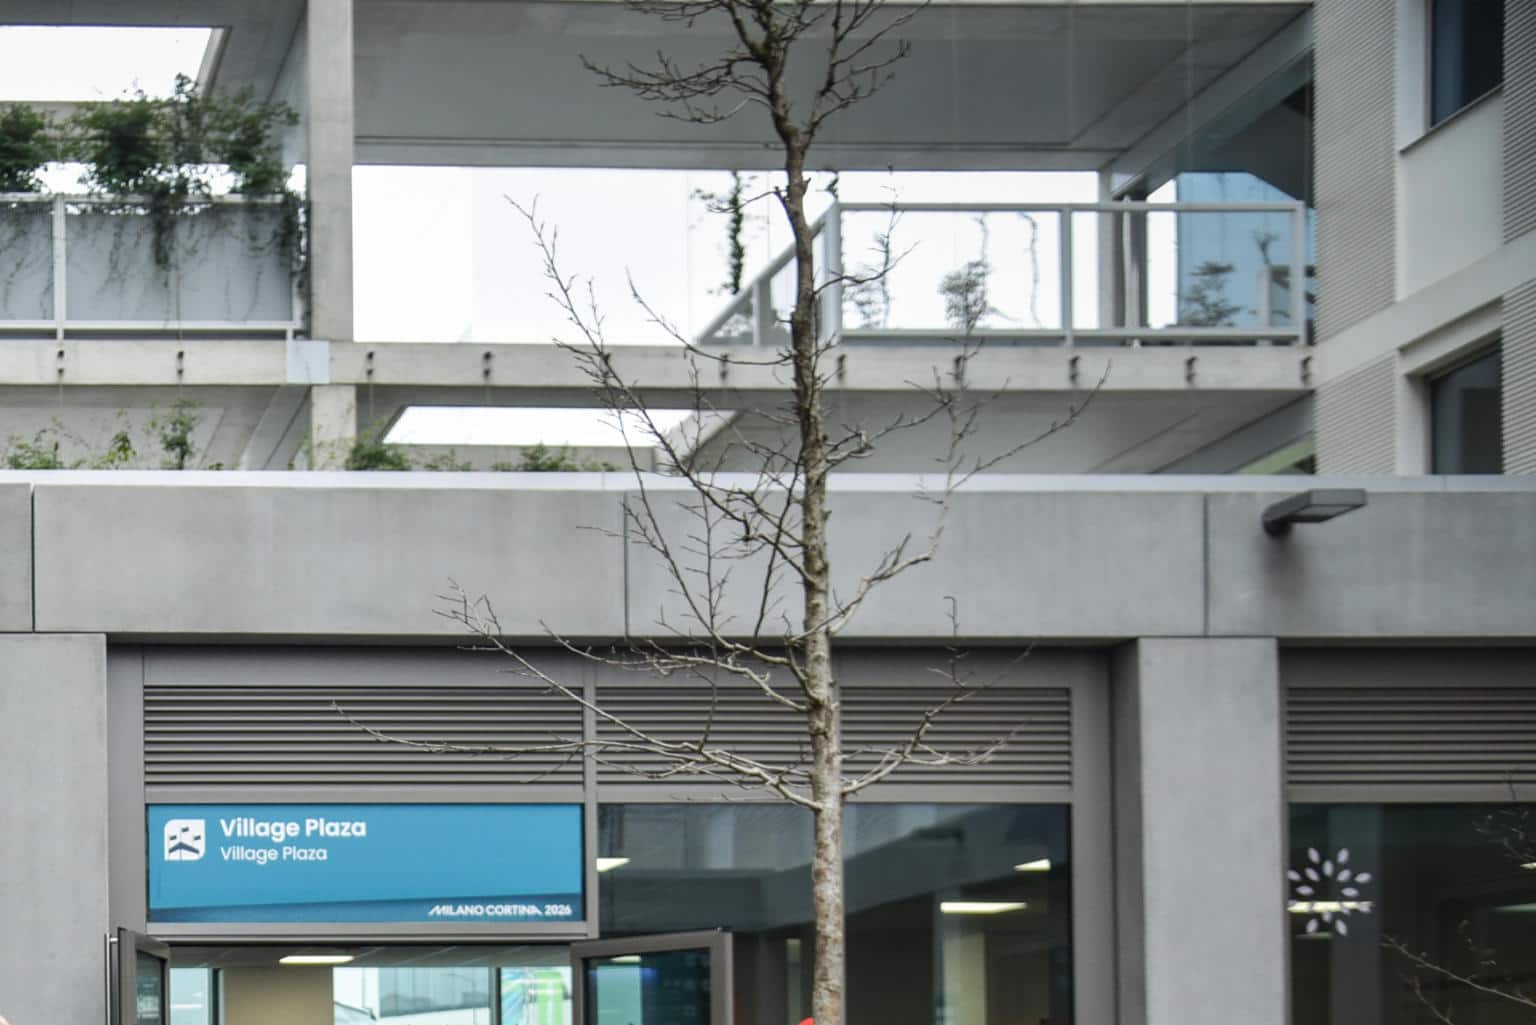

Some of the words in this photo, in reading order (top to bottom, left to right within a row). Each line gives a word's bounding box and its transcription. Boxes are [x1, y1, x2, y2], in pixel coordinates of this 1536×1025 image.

[220, 817, 300, 842] Village
[305, 818, 367, 837] Plaza
[220, 846, 279, 865] Village
[282, 846, 328, 861] Plaza
[428, 904, 484, 916] MILANO
[485, 904, 543, 916] CORTINA
[544, 904, 573, 916] 2026
